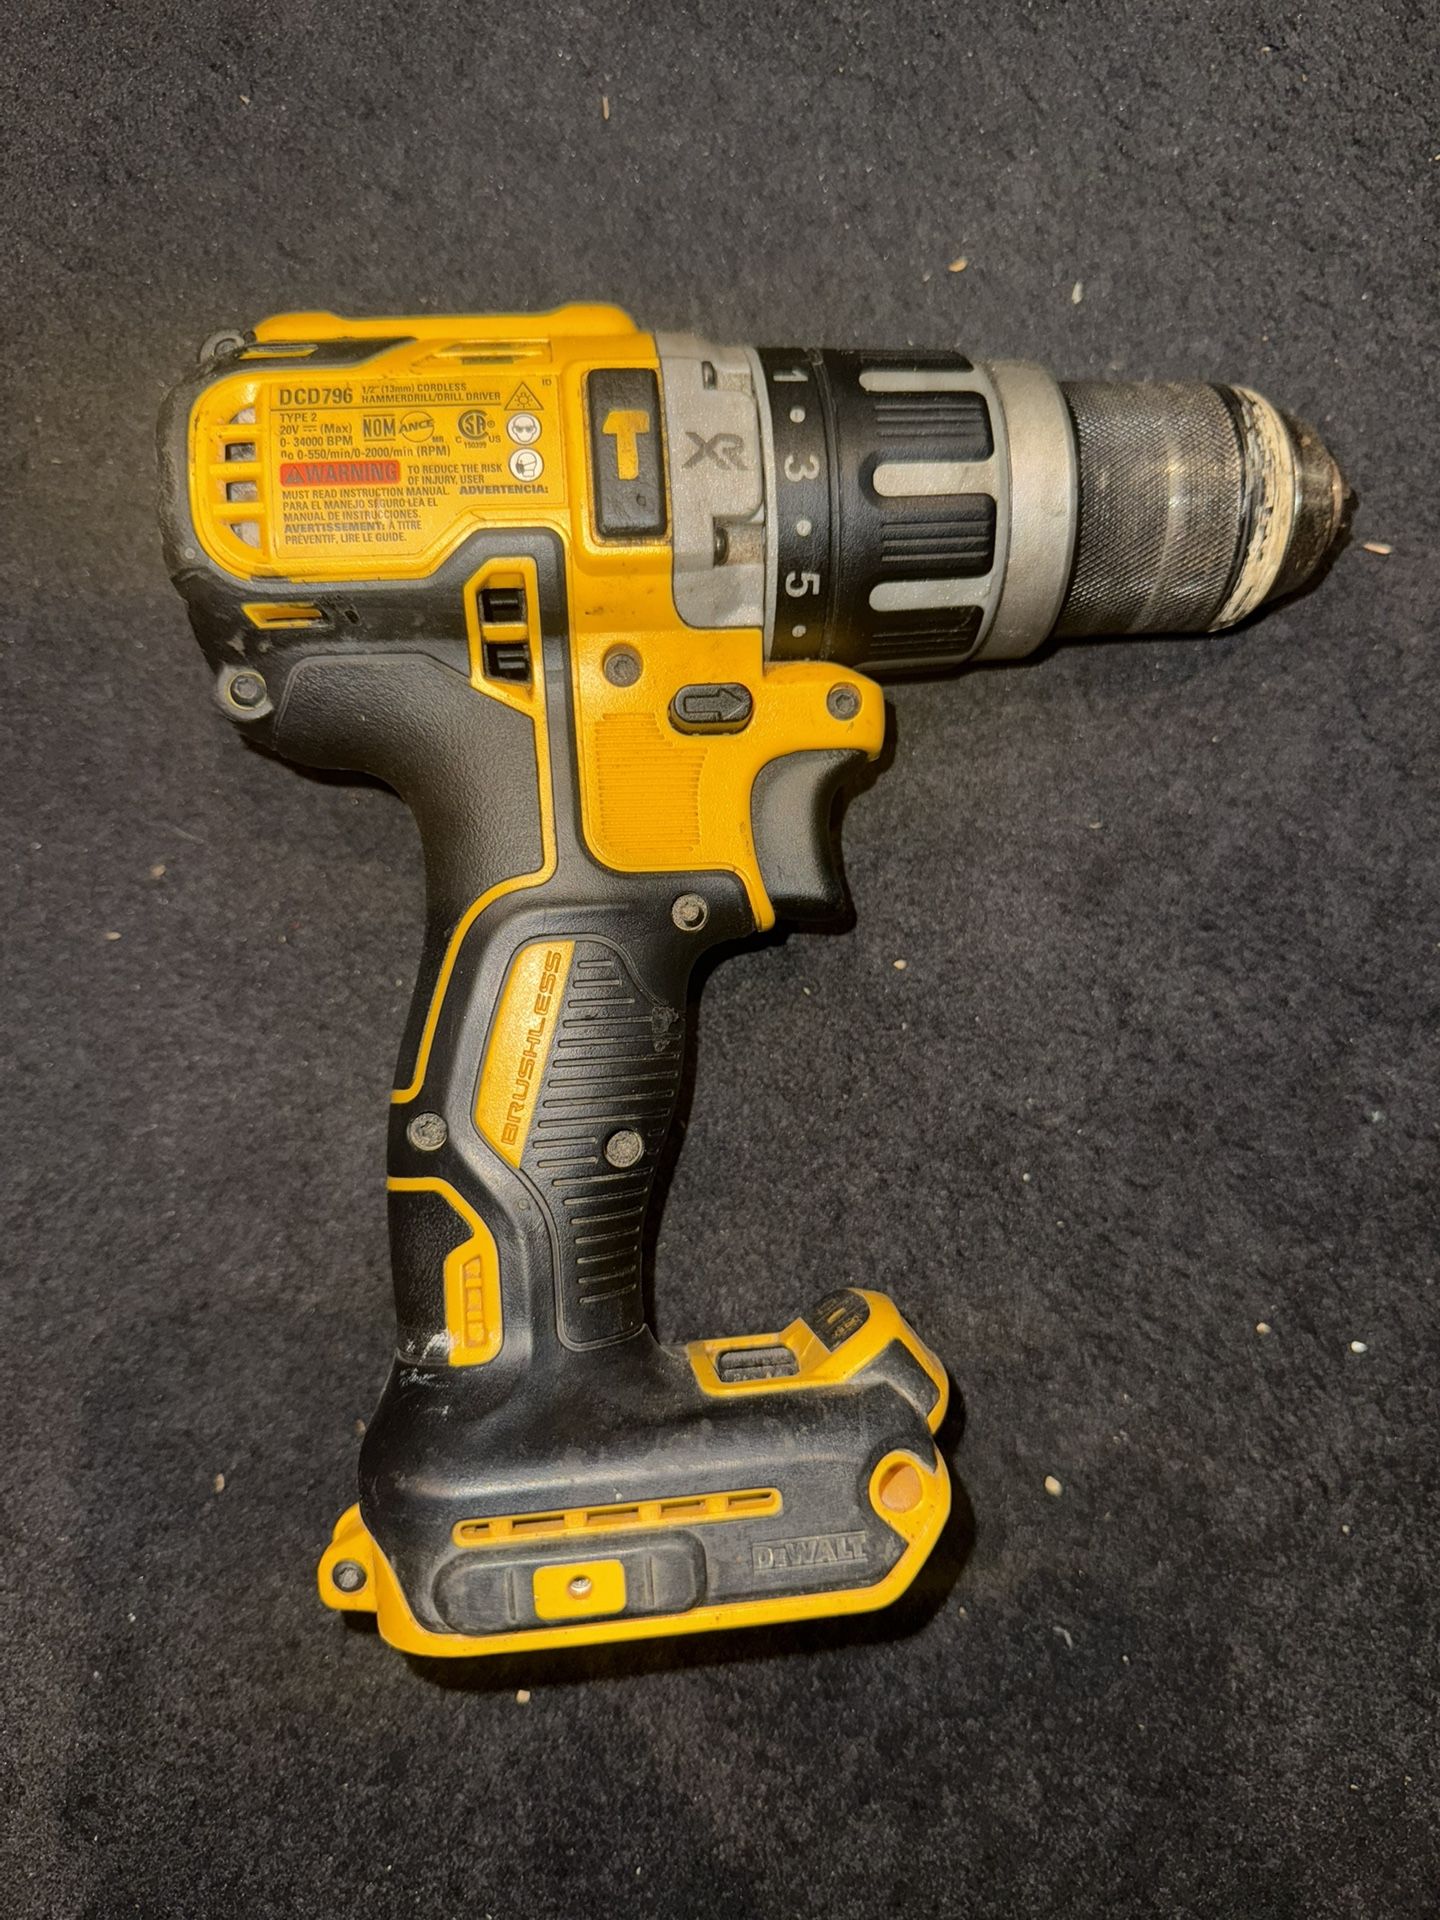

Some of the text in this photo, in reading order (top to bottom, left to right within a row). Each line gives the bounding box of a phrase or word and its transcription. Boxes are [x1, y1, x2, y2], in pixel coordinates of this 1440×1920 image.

[773, 369, 808, 381] 1
[381, 384, 415, 394] (13mm)
[417, 383, 467, 392] CORDLESS
[280, 387, 353, 405] DCD796
[361, 391, 500, 404] HAMMERDRILL/DRILL DRIVER
[280, 412, 317, 422] TYPE 2
[280, 423, 353, 434] 20V (Max)
[363, 418, 396, 438] NOM
[293, 437, 323, 447] 34000
[327, 436, 353, 446] BPM
[417, 445, 450, 457] (RPM)
[682, 432, 748, 470] XR
[305, 462, 396, 483] WARNING
[408, 464, 502, 474] TO REDUCE THE RISK
[784, 454, 820, 482] 3
[408, 477, 421, 485] OF
[461, 475, 484, 484] USER
[282, 485, 548, 499] MUST READ INSTRUCTION MANUAL. ADVERTENCIA:
[283, 498, 438, 511] PARA EL MANEJO SEGURO LEA EL
[284, 509, 421, 522] MANUAL DE INSTRUCCIONES.
[285, 522, 385, 533] AVERTISSEMENT:
[397, 521, 422, 530] TITRE
[341, 533, 360, 543] LIRE
[363, 533, 372, 542] LE
[376, 532, 407, 542] GUIDE.
[785, 571, 820, 597] 5
[501, 950, 562, 1145] BRUSHLESS
